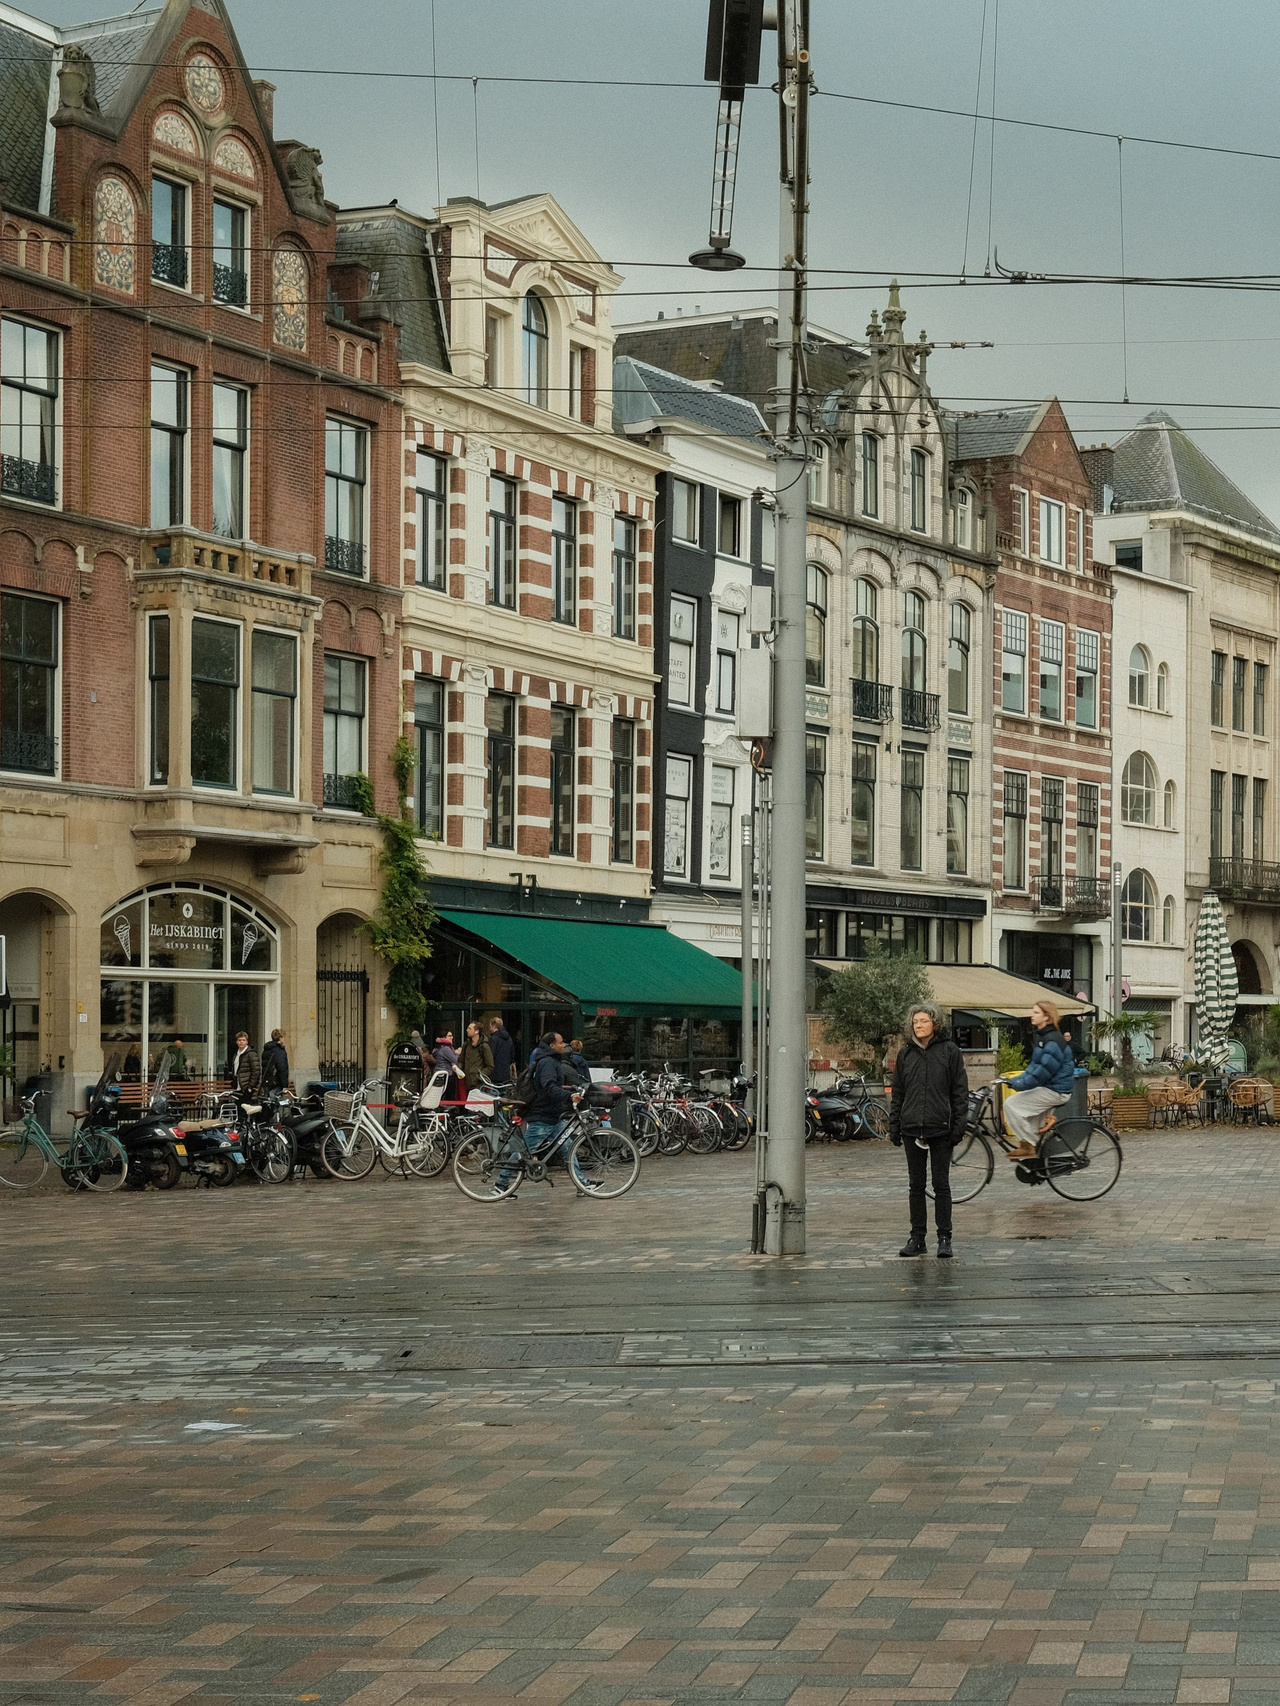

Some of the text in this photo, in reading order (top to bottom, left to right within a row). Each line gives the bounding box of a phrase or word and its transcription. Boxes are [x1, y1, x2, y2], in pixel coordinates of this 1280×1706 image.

[669, 658, 683, 668] TAFF
[669, 669, 686, 680] ANTED
[861, 894, 930, 909] BAGELS BEANS
[150, 923, 164, 936] Het
[166, 942, 189, 950] SINDS
